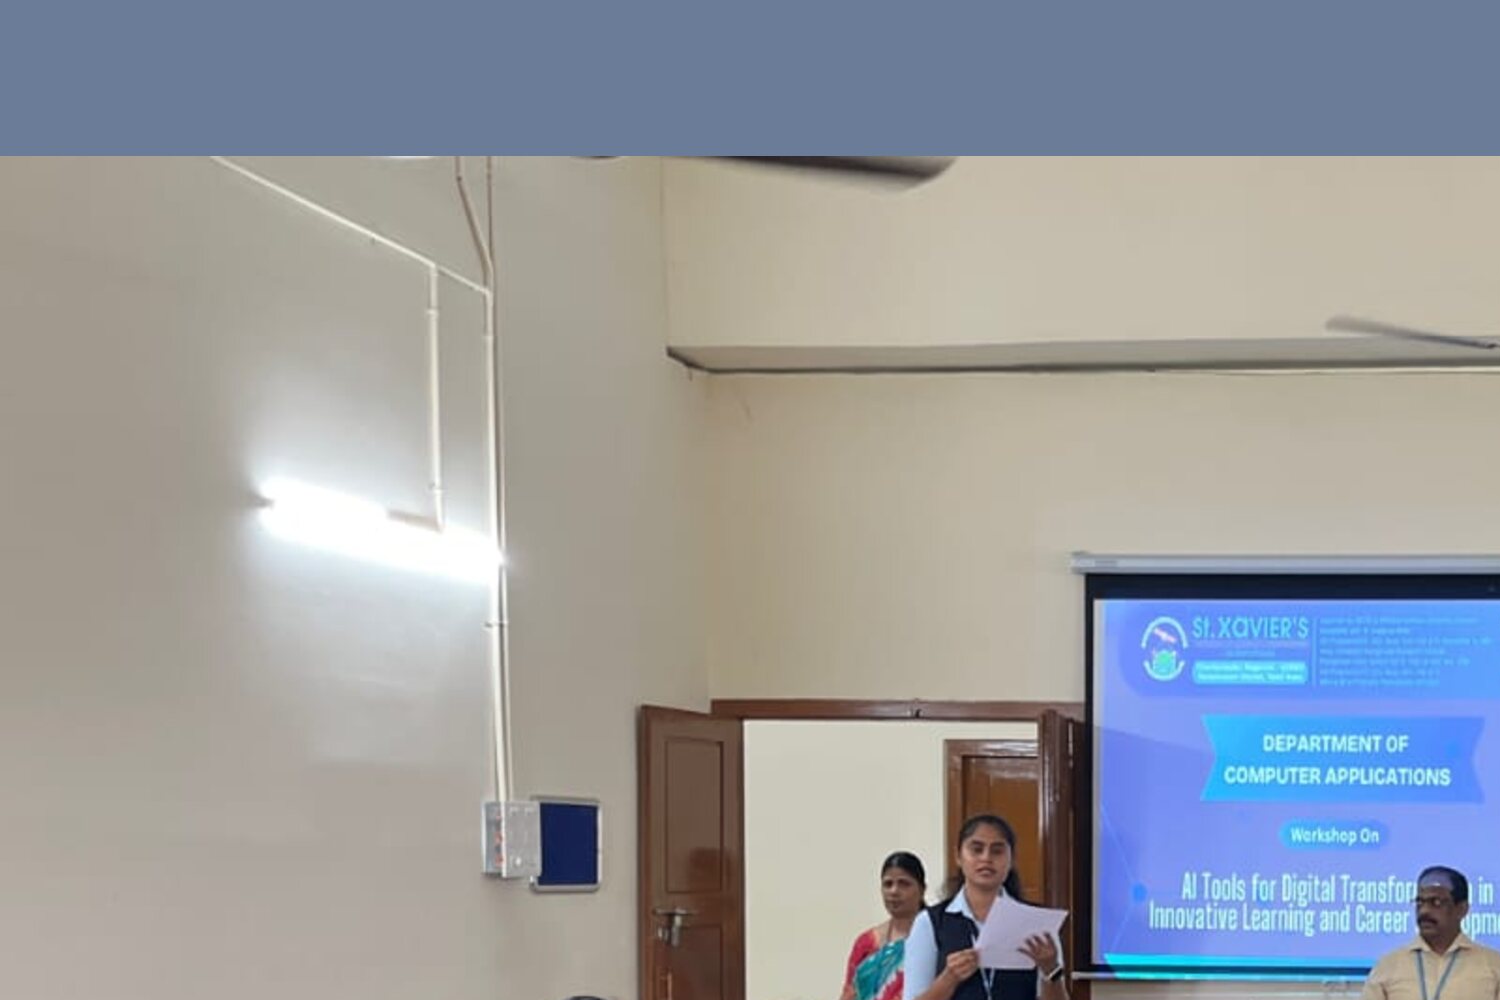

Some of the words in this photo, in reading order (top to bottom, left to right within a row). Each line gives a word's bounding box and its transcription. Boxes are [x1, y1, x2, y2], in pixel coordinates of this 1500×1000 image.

[1192, 616, 1215, 638] St.
[1262, 734, 1382, 753] DEPARTMENT
[1385, 735, 1410, 753] OF
[1223, 765, 1321, 786] COMPUTER
[1324, 766, 1452, 787] APPLICATIONS
[1290, 826, 1357, 847] Workshop
[1360, 827, 1380, 843] On
[1181, 871, 1198, 901] AI
[1201, 871, 1247, 902] Tools
[1251, 872, 1277, 902] for
[1281, 873, 1336, 908] Digital
[1339, 873, 1475, 904] Transfor
[1478, 876, 1495, 904] in
[1148, 899, 1239, 931] Innovative
[1242, 901, 1316, 938] Learning
[1319, 903, 1351, 933] and
[1355, 903, 1411, 934] Career
